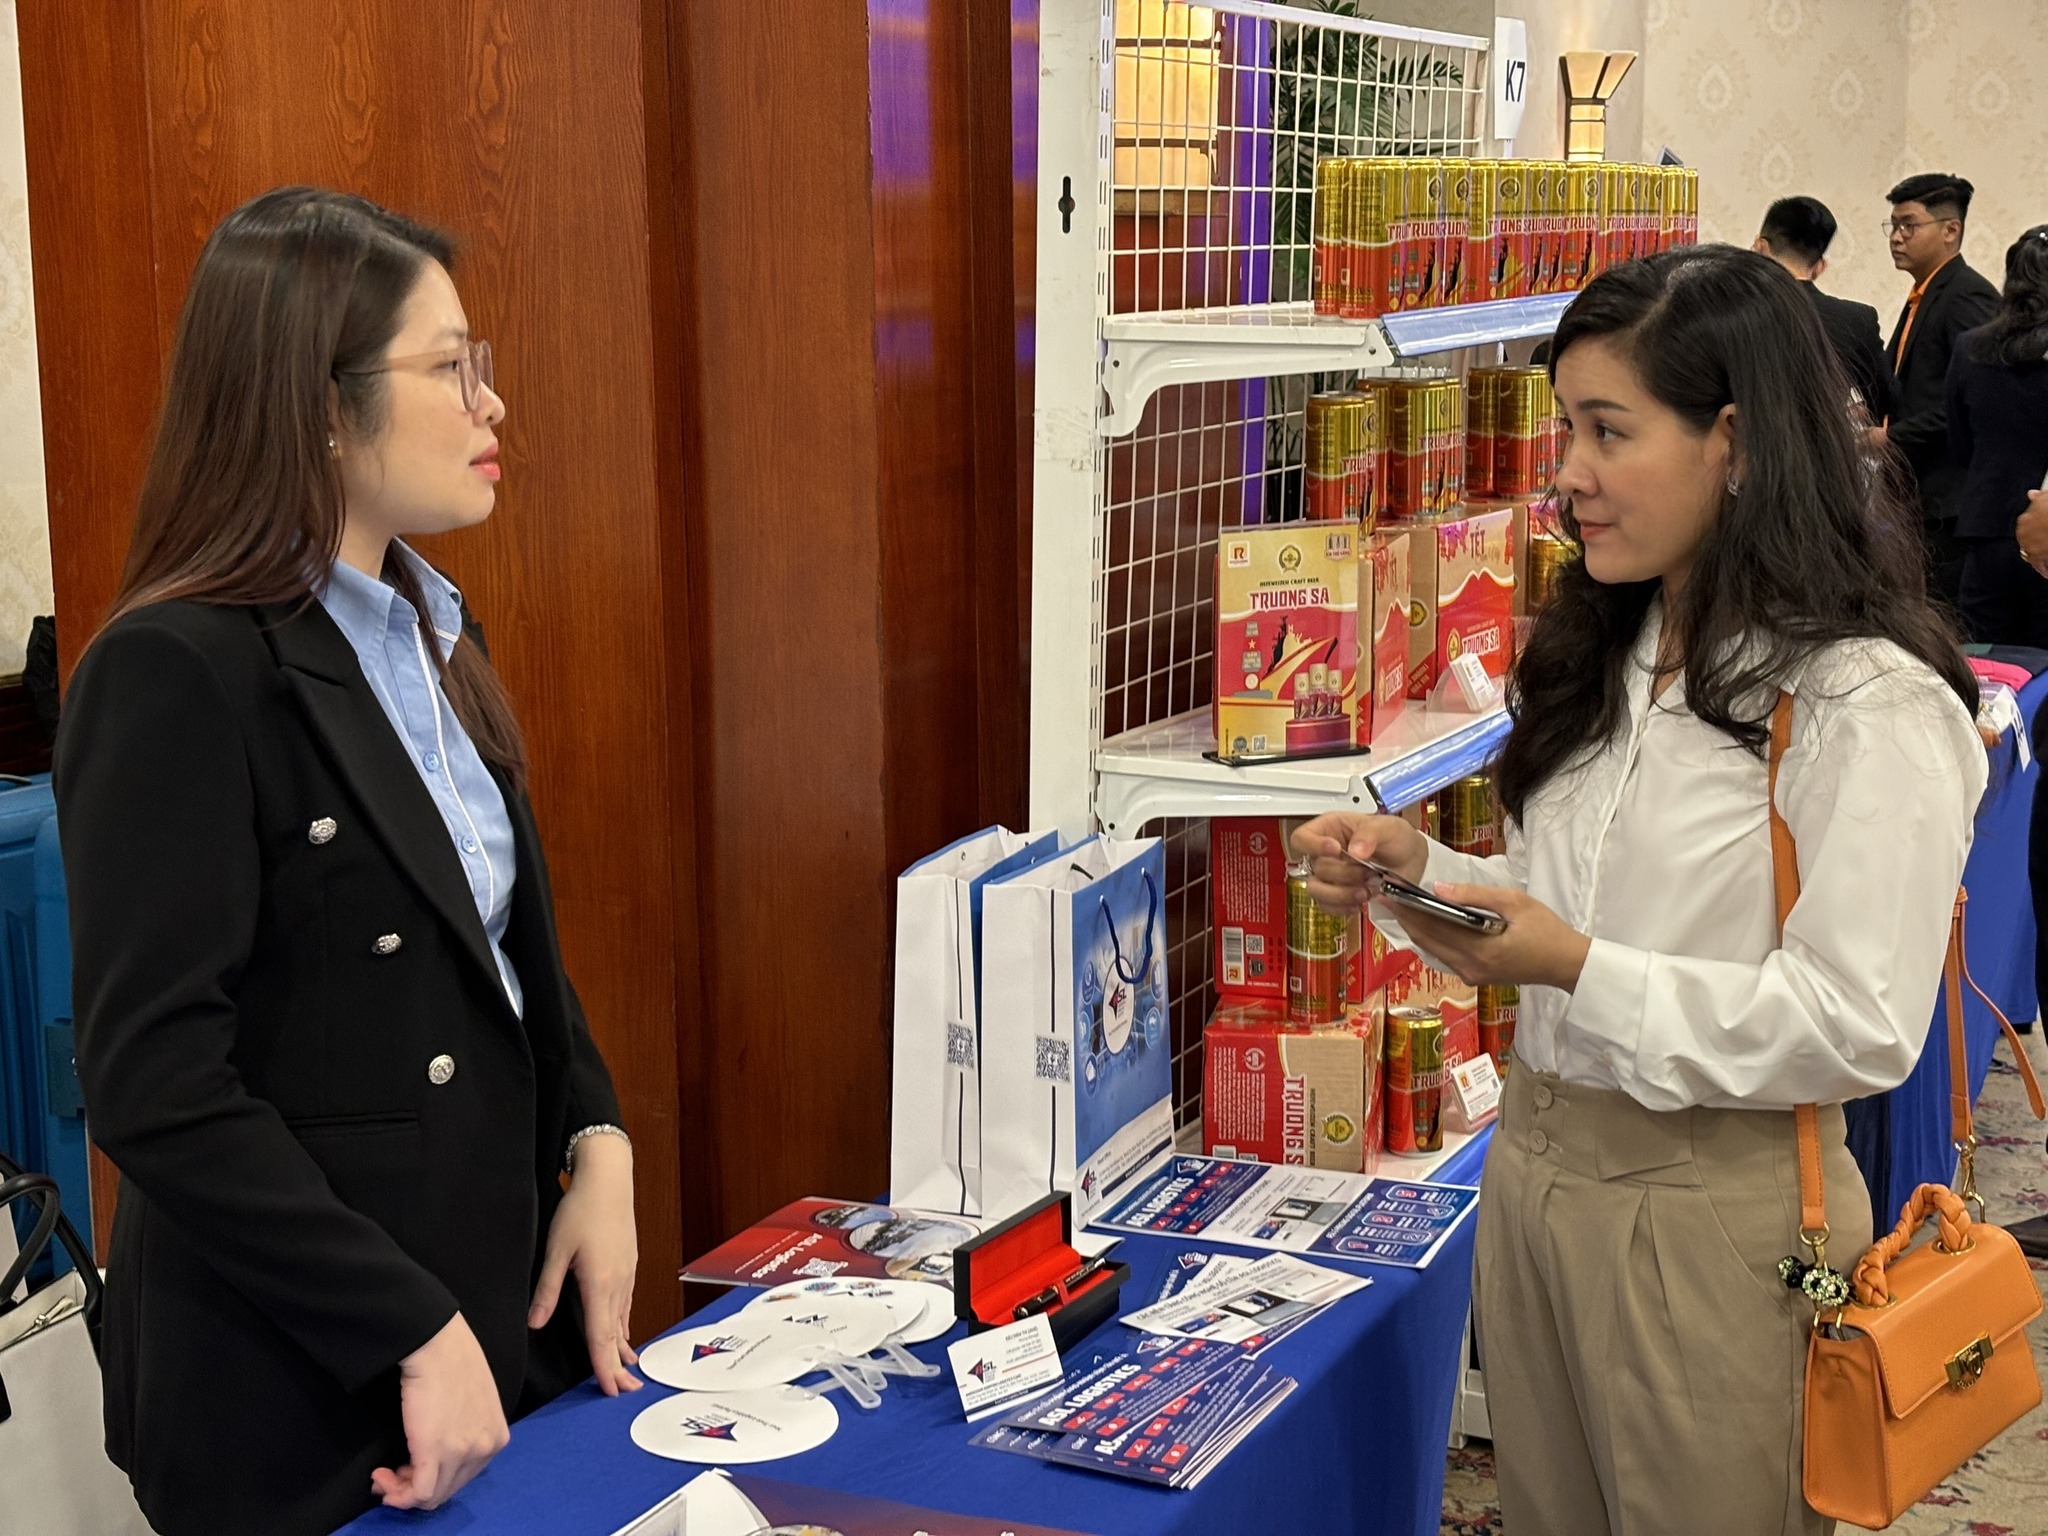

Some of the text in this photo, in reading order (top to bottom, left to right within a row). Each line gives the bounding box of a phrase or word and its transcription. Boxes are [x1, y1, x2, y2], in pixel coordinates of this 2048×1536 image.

[1506, 60, 1525, 102] K7
[1470, 522, 1486, 559] TẾT
[1250, 587, 1330, 610] TRUONG SA
[1490, 627, 1500, 650] SA
[1285, 1077, 1304, 1149] TRUONG
[1038, 1406, 1076, 1427] ASL
[1064, 1363, 1142, 1408] LOGISTICS
